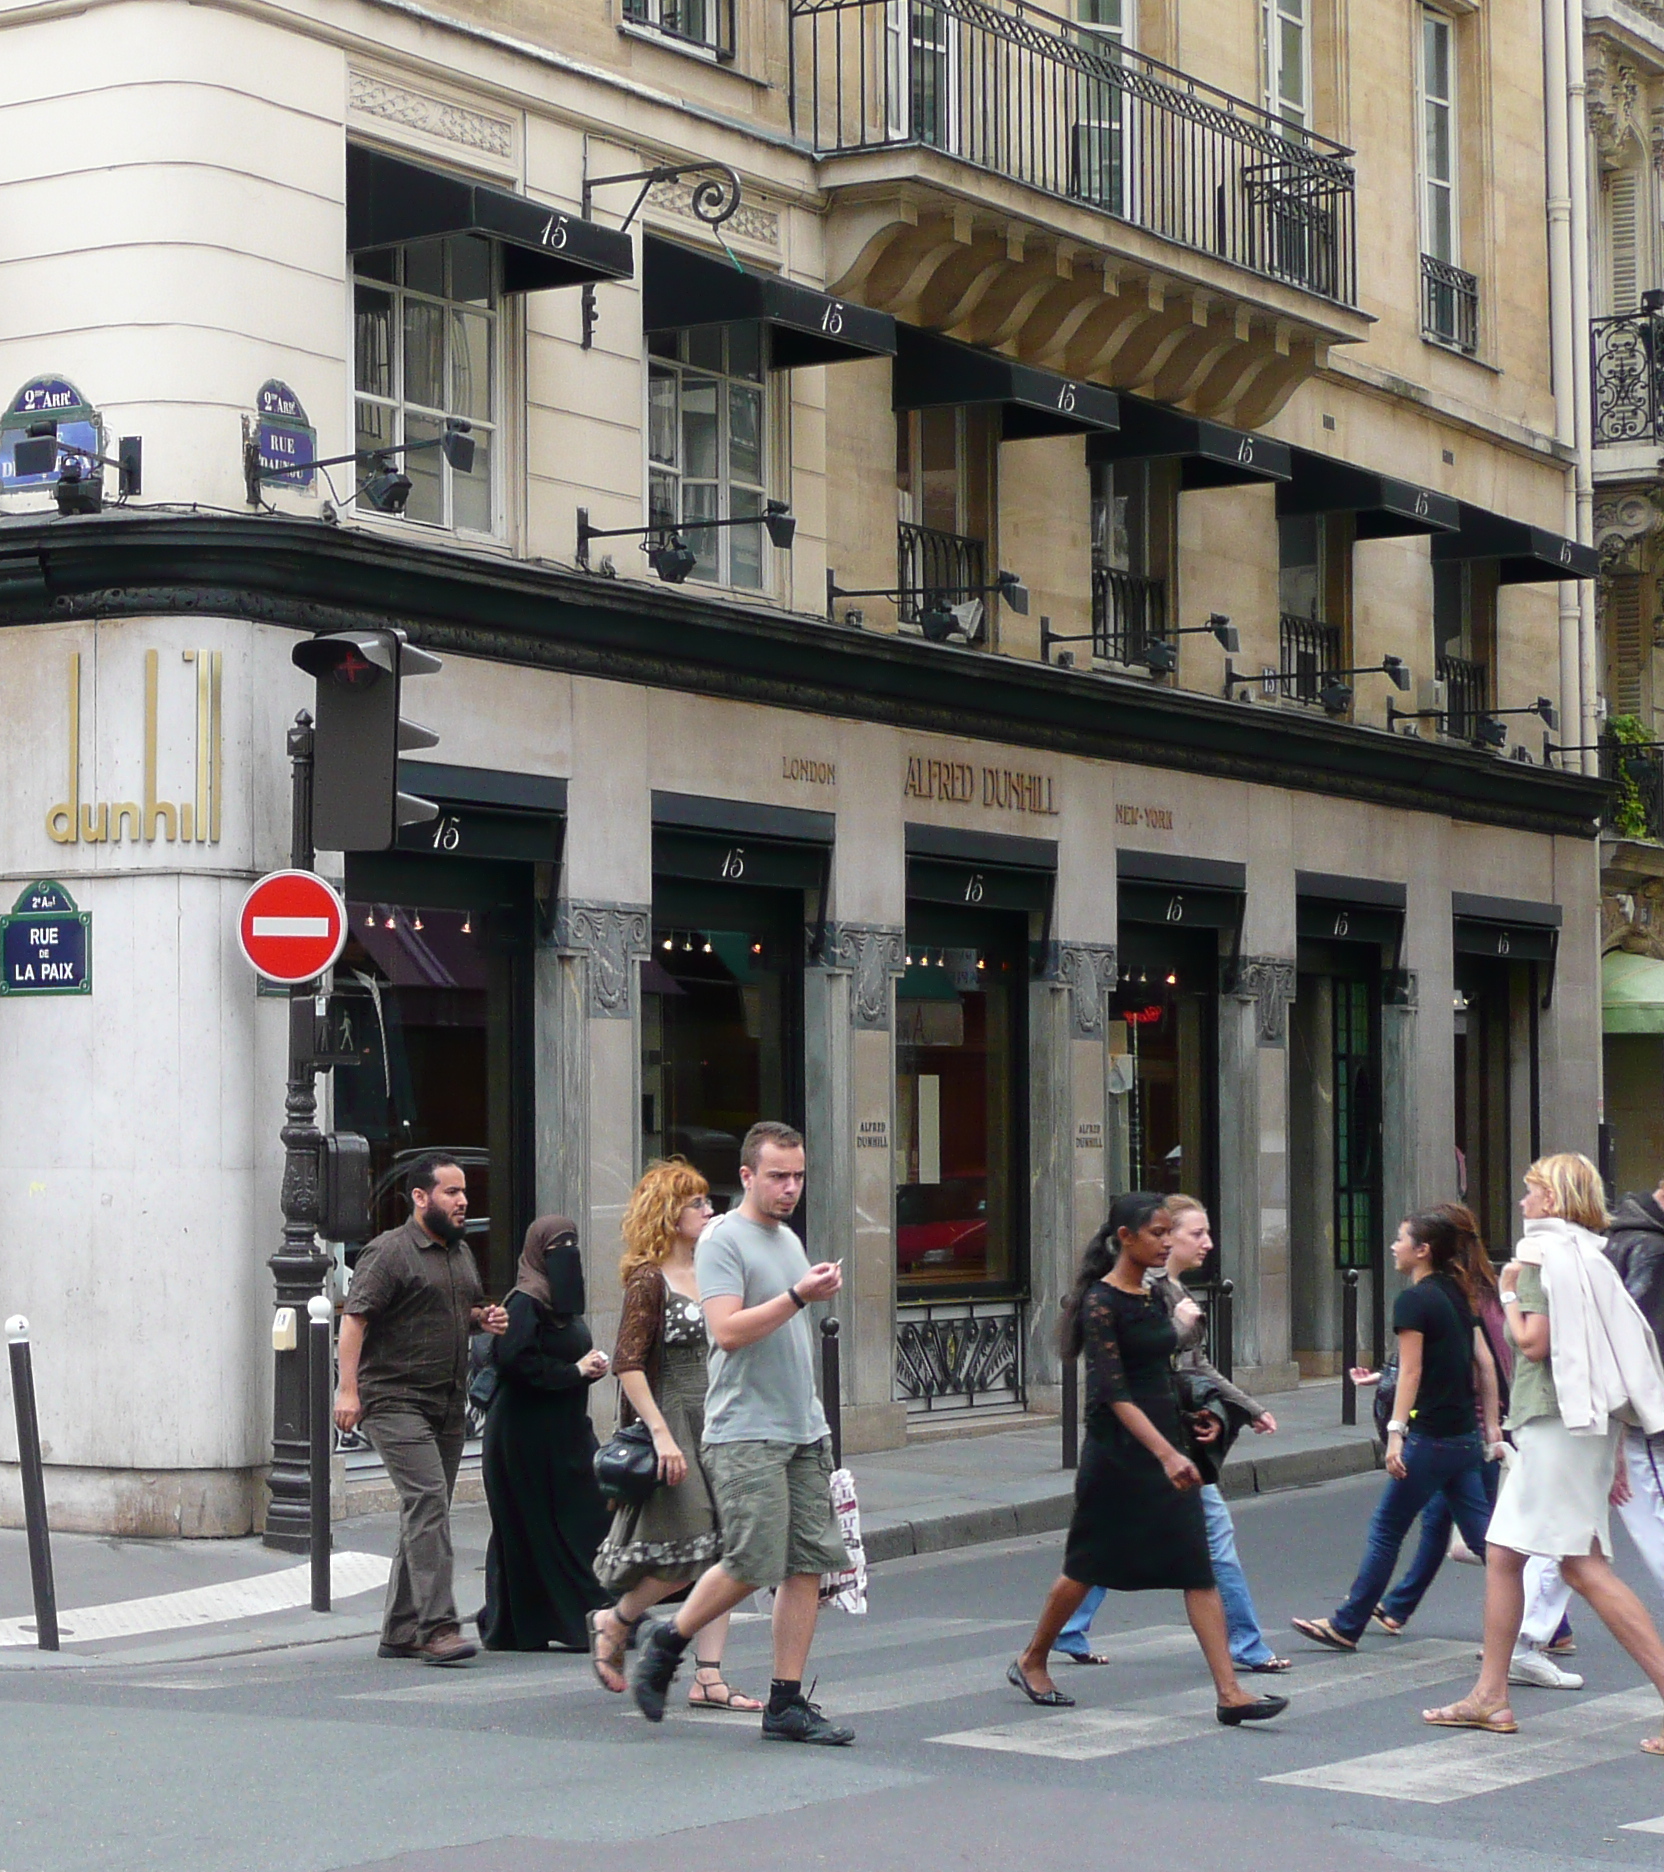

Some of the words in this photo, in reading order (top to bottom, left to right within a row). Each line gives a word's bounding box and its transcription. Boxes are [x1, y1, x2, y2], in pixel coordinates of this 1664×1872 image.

[540, 214, 569, 249] 15
[820, 302, 844, 334] 15
[1056, 383, 1077, 412] 15
[270, 434, 295, 455] RUE
[1237, 437, 1254, 464] 15
[1414, 491, 1433, 516] 15
[1560, 540, 1572, 565] 15
[46, 648, 222, 843] dunhill
[782, 756, 836, 786] LONDON
[904, 756, 975, 804] ALFRED
[982, 766, 1060, 816] DUNHILL
[433, 817, 461, 850] 15
[722, 848, 744, 878] 15
[965, 874, 984, 902] 15
[1166, 895, 1184, 921] 15
[30, 927, 59, 945] RUE
[1334, 912, 1348, 936] 15
[38, 949, 50, 959] DE
[15, 963, 35, 981] LA
[41, 962, 74, 981] PAIX
